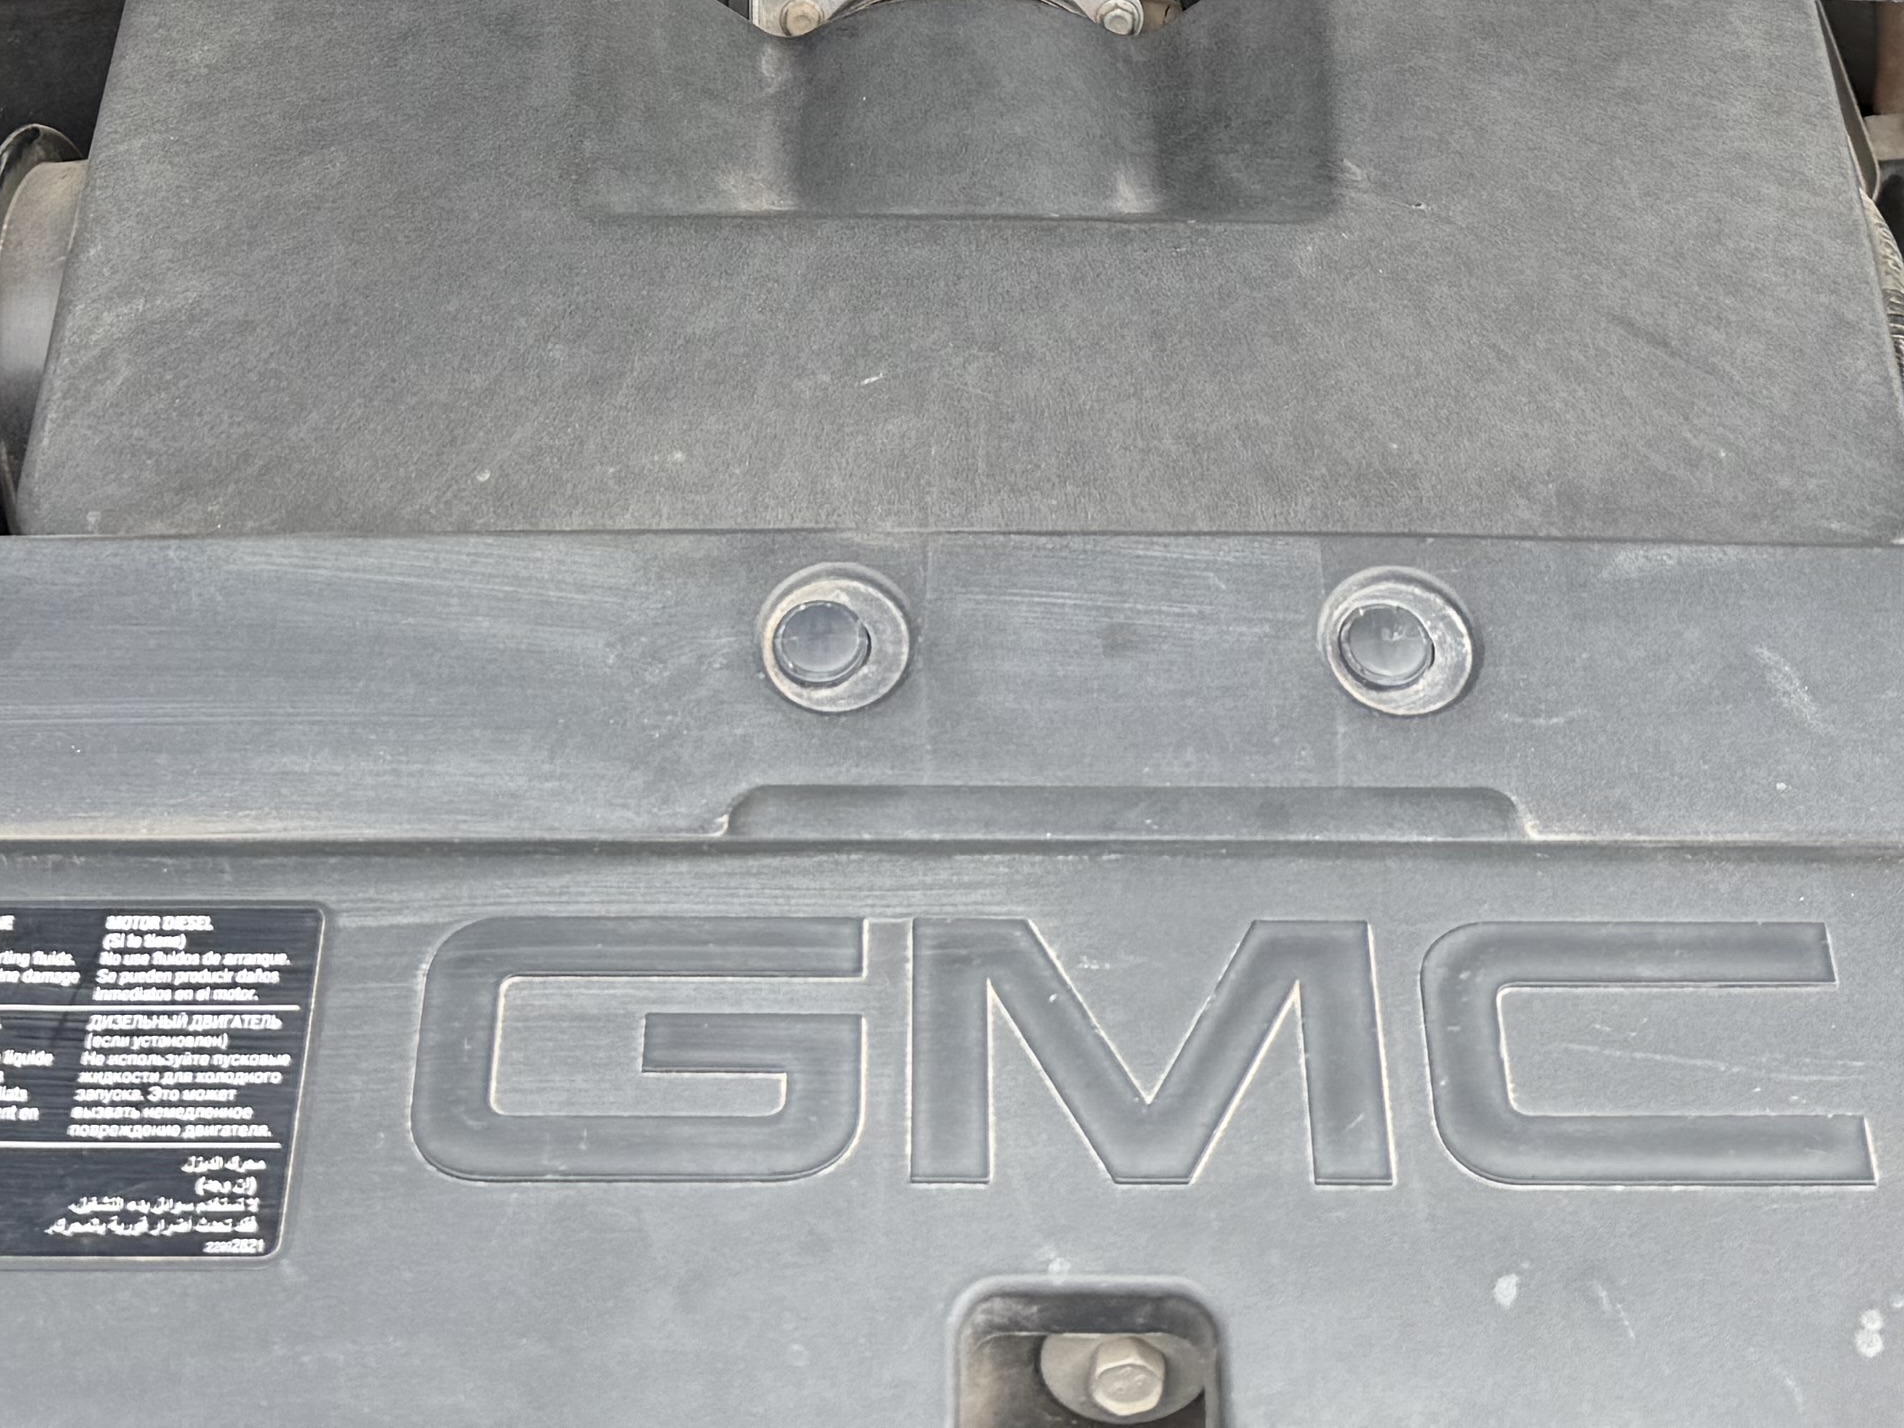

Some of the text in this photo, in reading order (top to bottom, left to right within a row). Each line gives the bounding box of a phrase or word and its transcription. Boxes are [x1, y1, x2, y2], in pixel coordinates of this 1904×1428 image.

[105, 915, 214, 931] MOTOR DIESEL
[31, 951, 76, 966] fluids.
[99, 951, 291, 967] No use fluidos de arranque.
[21, 969, 80, 986] damage
[96, 968, 280, 986] Se pueden producir daños
[174, 989, 194, 1001] en
[196, 987, 210, 1001] el
[213, 987, 259, 1001] motor.
[3, 1049, 55, 1068] liquide
[409, 916, 1879, 1189] GMC
[18, 1107, 40, 1121] en
